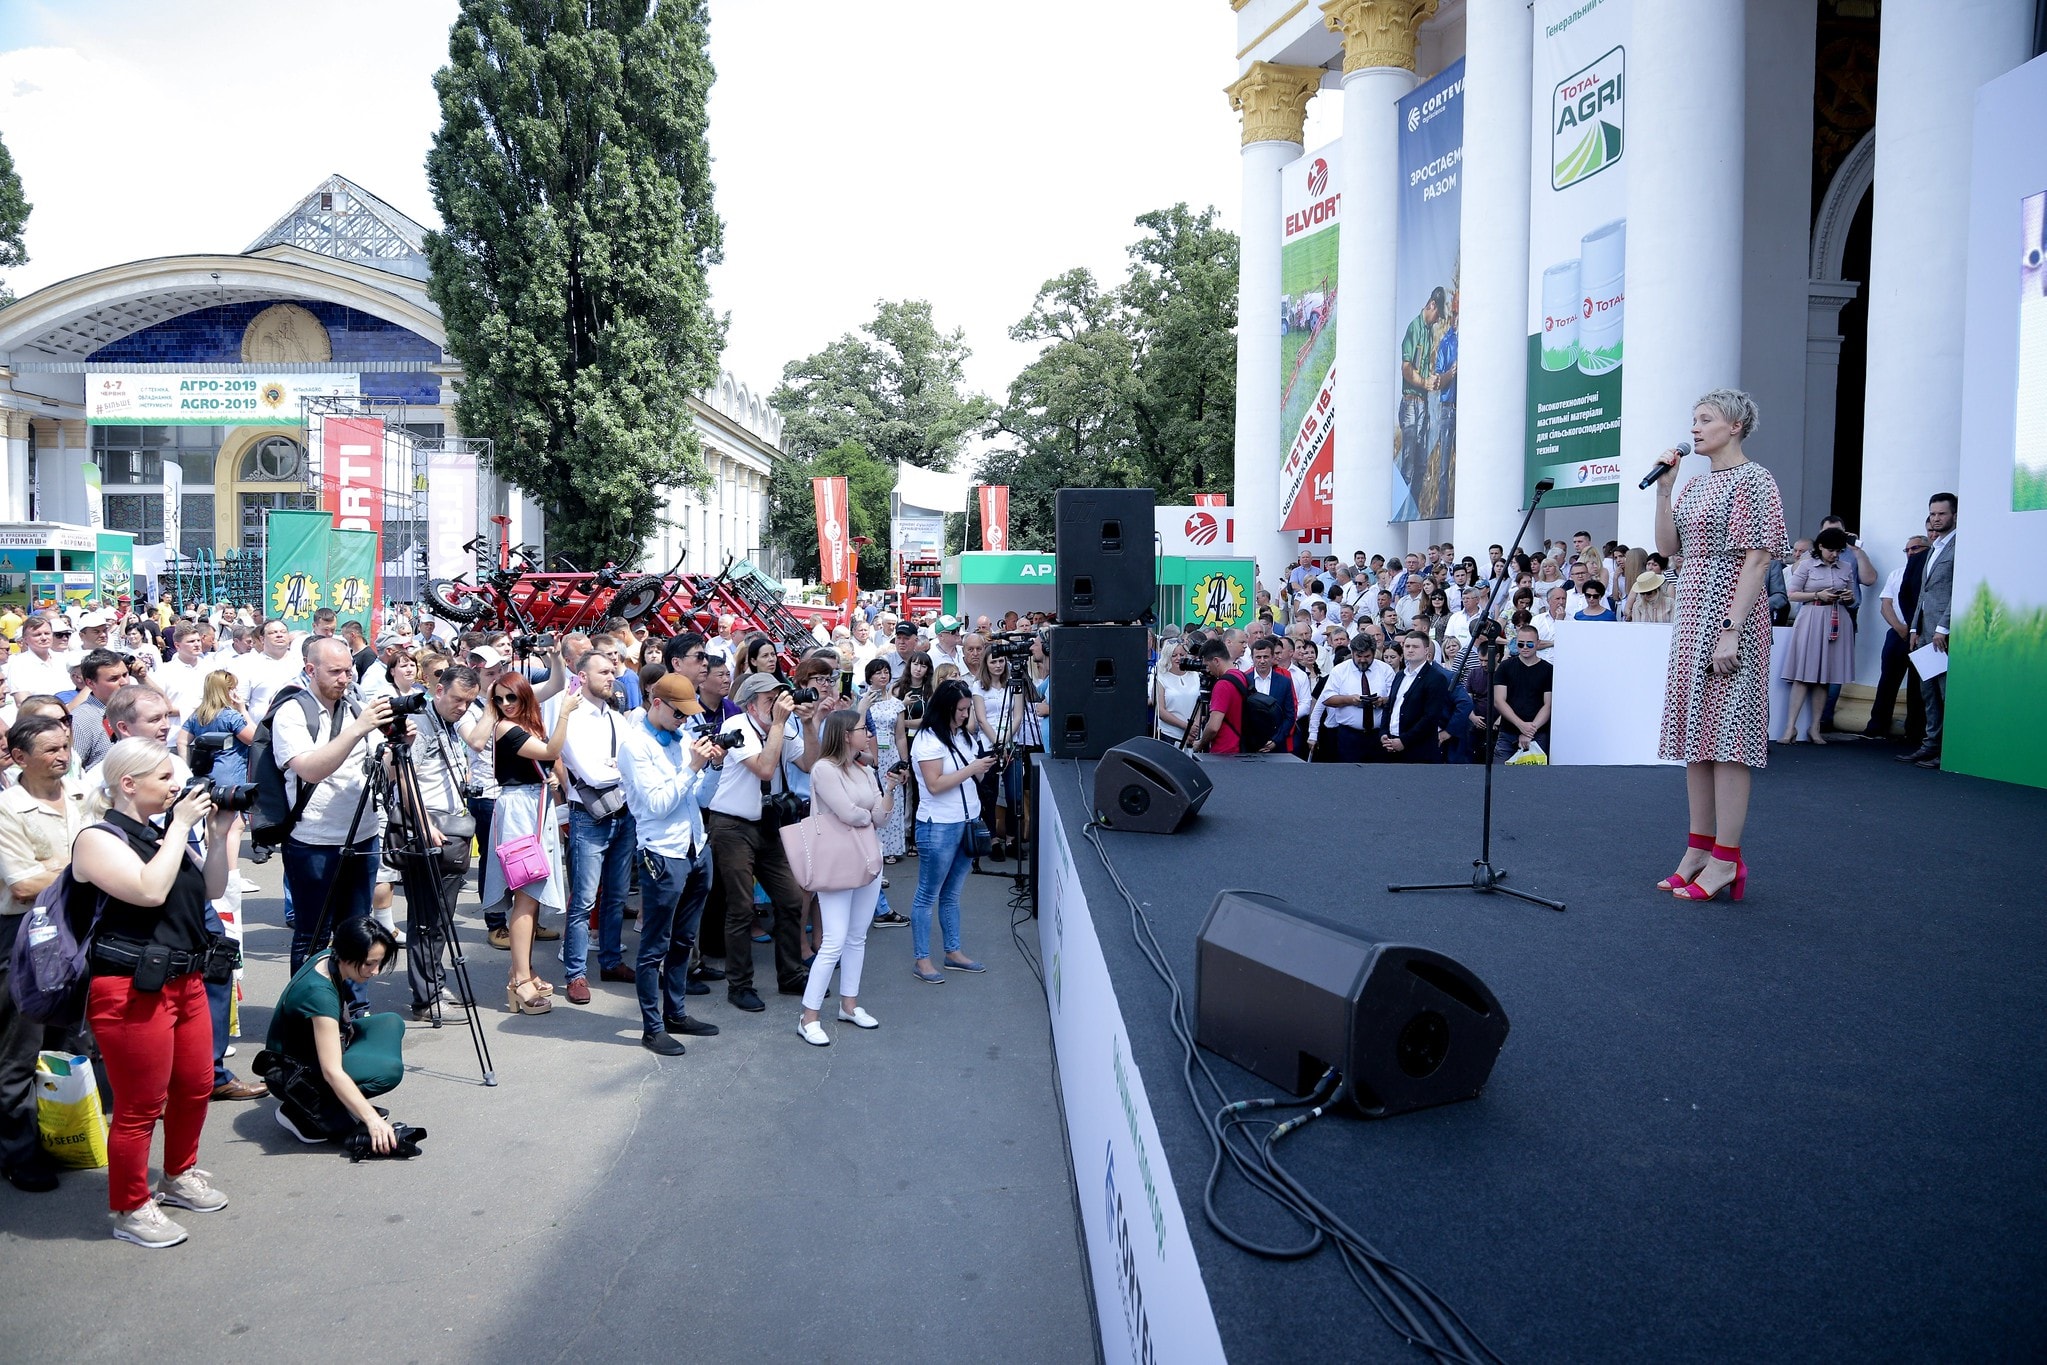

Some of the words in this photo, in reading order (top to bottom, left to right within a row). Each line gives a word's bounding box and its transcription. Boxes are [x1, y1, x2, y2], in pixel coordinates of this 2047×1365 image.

[1561, 73, 1600, 101] TOTAL
[1556, 73, 1622, 135] AGRI
[1423, 172, 1457, 202] РАЗОМ
[1595, 292, 1625, 312] TOTAL
[1555, 314, 1578, 328] TOTAL
[103, 380, 122, 390] 4-7
[180, 380, 257, 391] АГРО-2019
[180, 398, 257, 409] AGRO-2019
[1537, 391, 1599, 413] Високотехнологічні
[1537, 412, 1570, 428] мастильні
[1570, 407, 1603, 421] матеріали
[1285, 414, 1318, 477] TETIS
[1536, 432, 1548, 443] для
[1536, 444, 1559, 456] техніки
[1282, 433, 1324, 516] ОБПРИСКУВАЧІ
[1590, 463, 1621, 475] TOTAL
[1314, 471, 1333, 495] 14
[1020, 563, 1056, 577] АР
[55, 1133, 86, 1145] SEEDS
